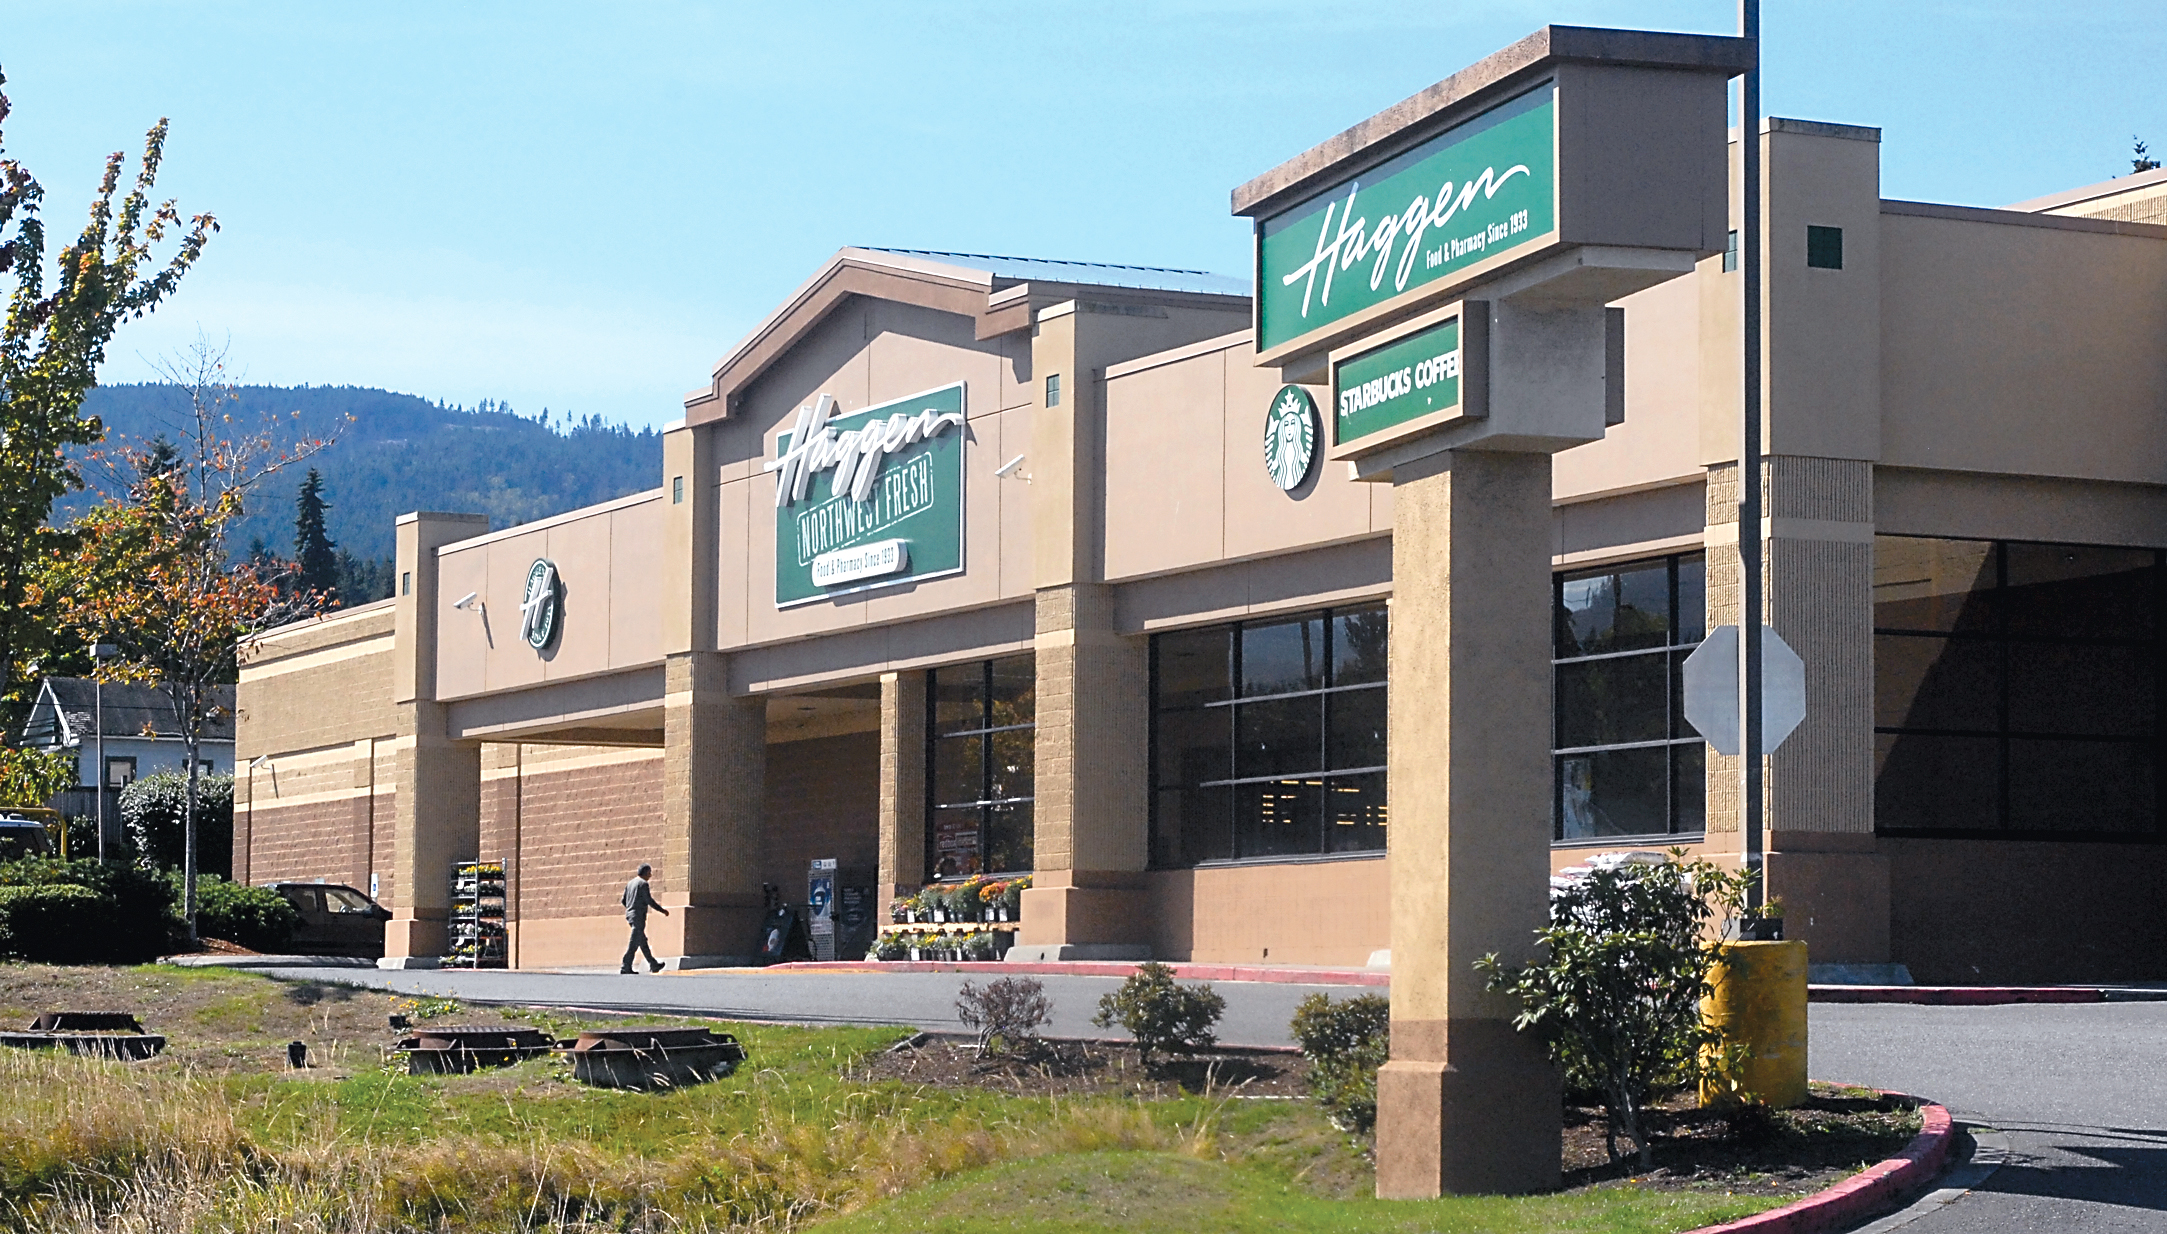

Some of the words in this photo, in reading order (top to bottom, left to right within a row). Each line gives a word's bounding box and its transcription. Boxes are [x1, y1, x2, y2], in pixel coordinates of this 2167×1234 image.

[1283, 164, 1530, 318] Haggen
[1426, 245, 1443, 269] Food
[1444, 242, 1450, 262] &
[1451, 231, 1485, 259] Pharmacy
[1487, 222, 1508, 244] Since
[1510, 209, 1528, 234] 1933
[1340, 366, 1412, 416] STARBUCKS
[763, 392, 966, 507] Haggen
[801, 482, 880, 559] NORTHWEST
[885, 459, 928, 520] FRESH
[817, 560, 830, 577] Food
[836, 557, 863, 574] Pharmacy
[864, 551, 880, 568] Since
[881, 546, 894, 565] 1933
